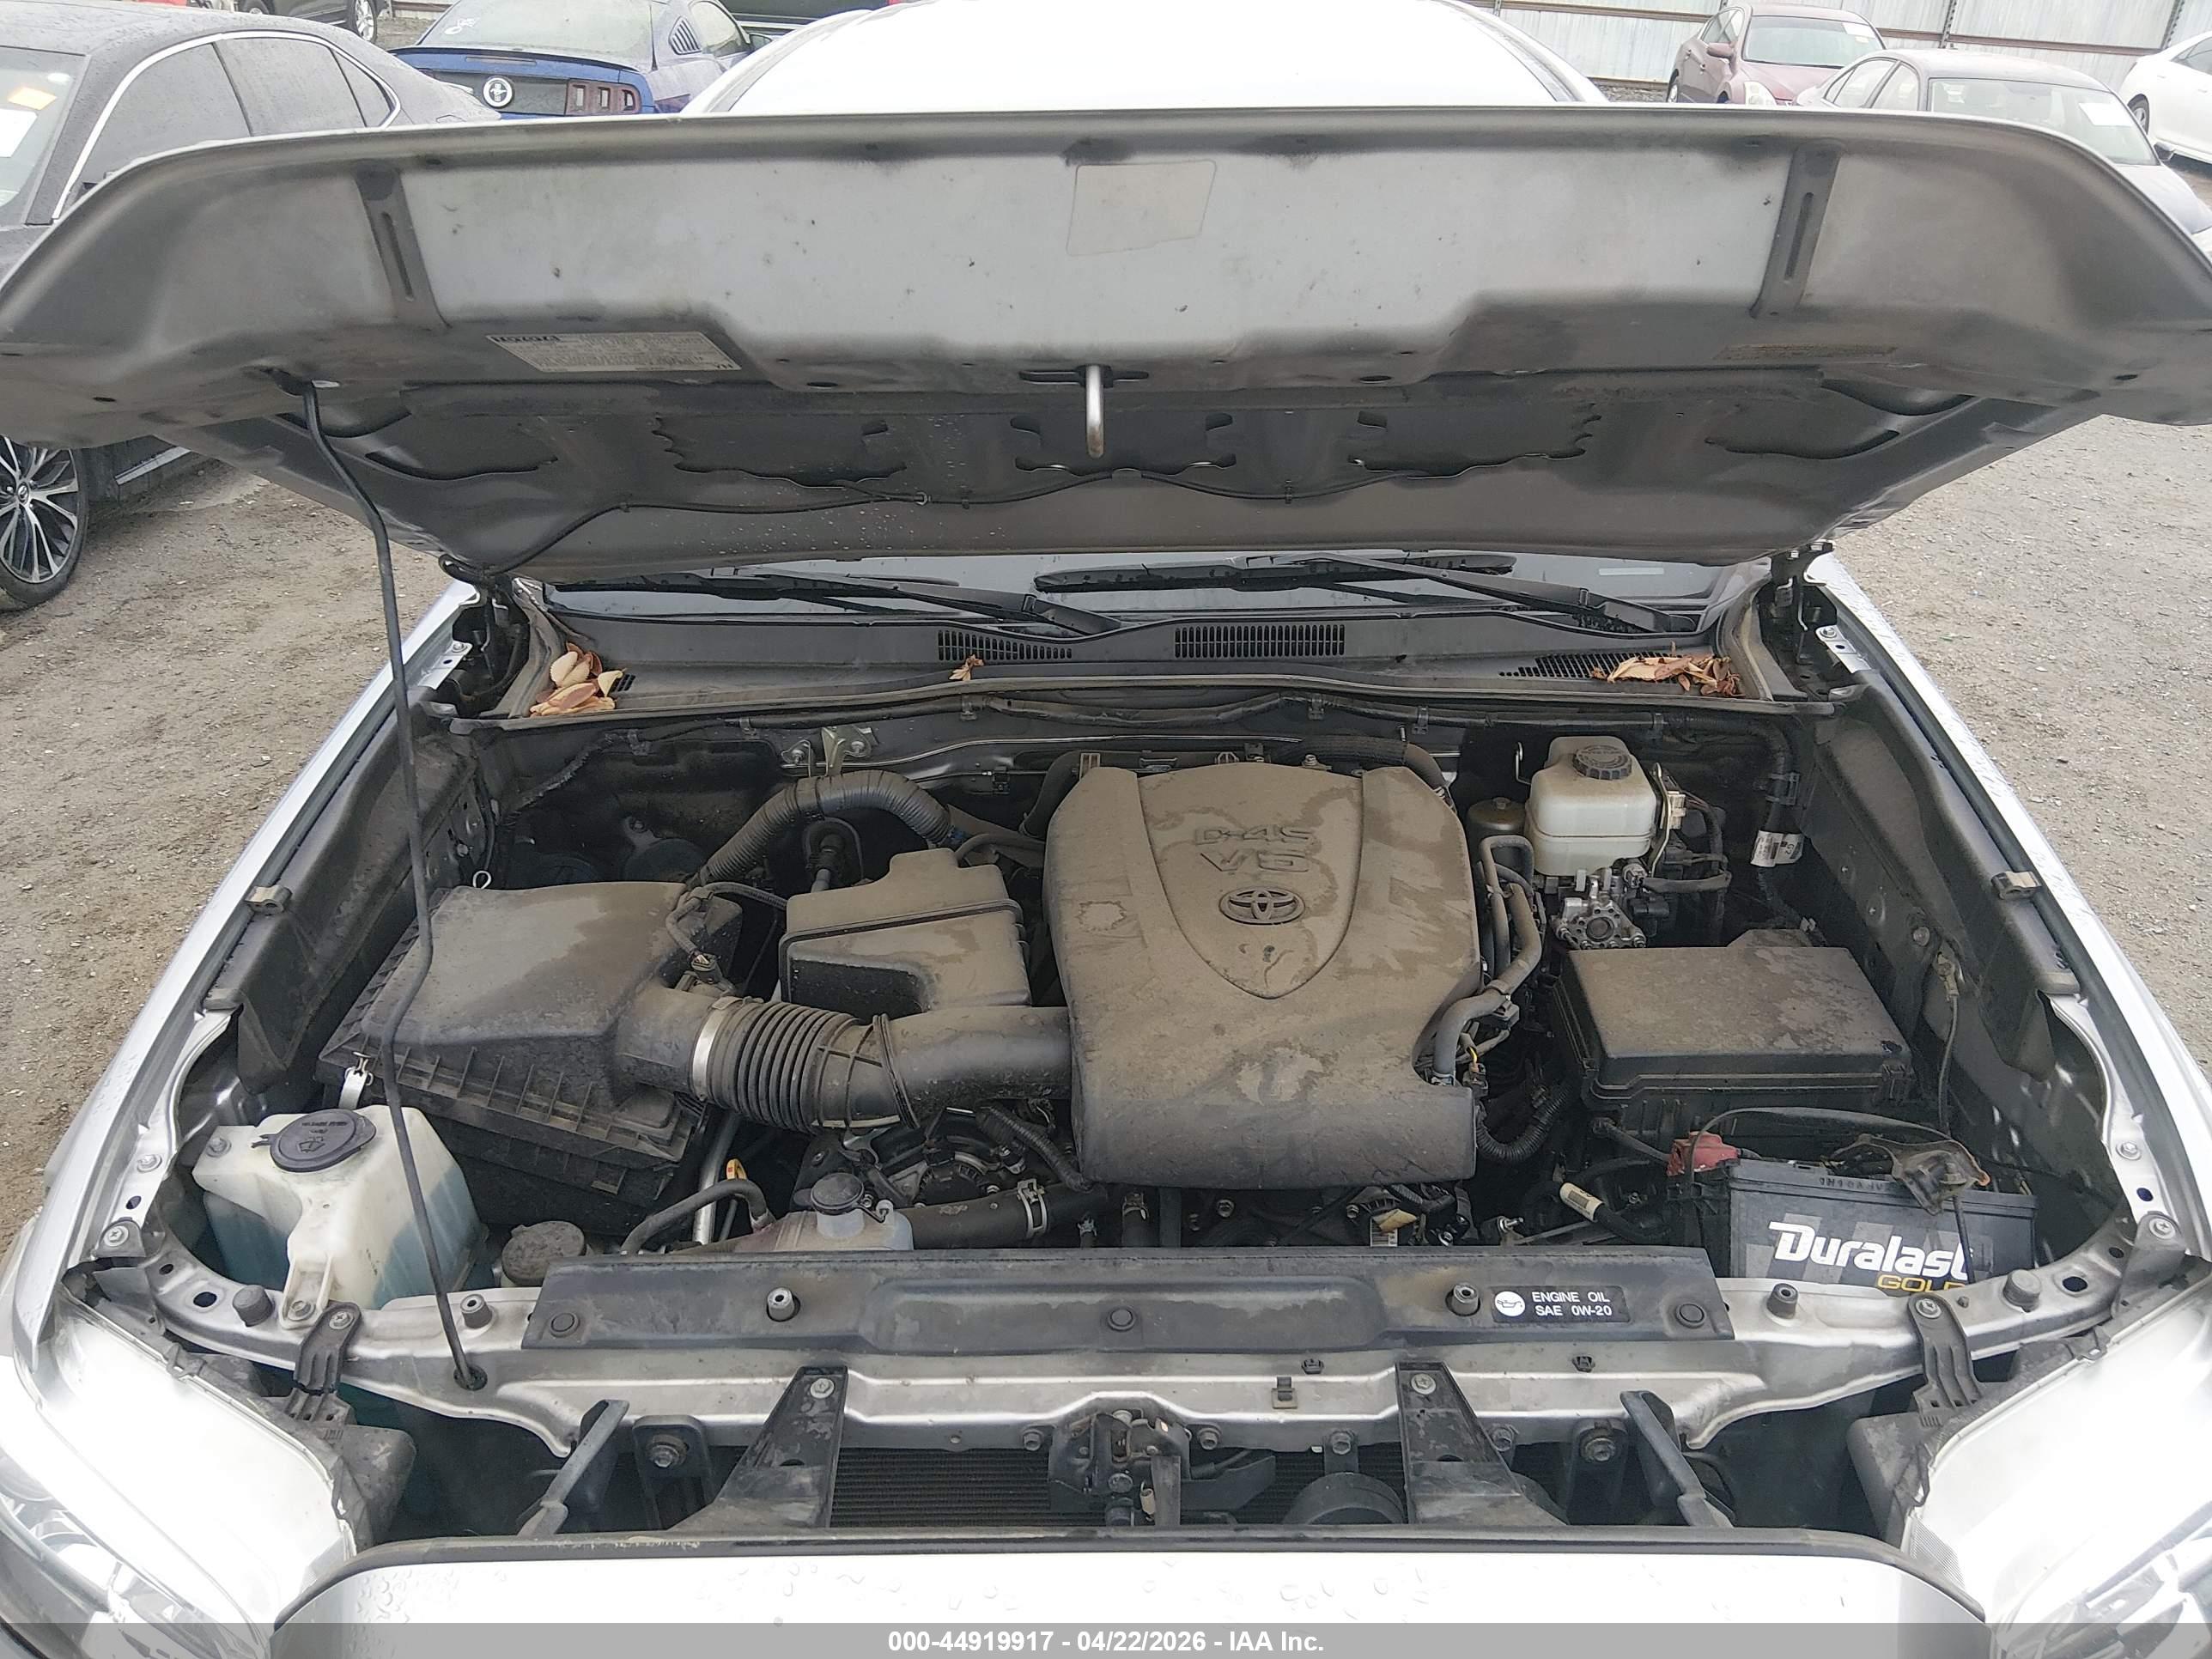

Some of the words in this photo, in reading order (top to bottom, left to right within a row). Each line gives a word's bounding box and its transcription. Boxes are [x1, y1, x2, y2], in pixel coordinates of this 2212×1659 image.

[1769, 1222, 1969, 1281] Duralast
[1532, 1291, 1580, 1303] ENGINE
[1588, 1291, 1611, 1303] OIL
[1534, 1305, 1563, 1316] SAE
[1571, 1305, 1613, 1316] 0W-20
